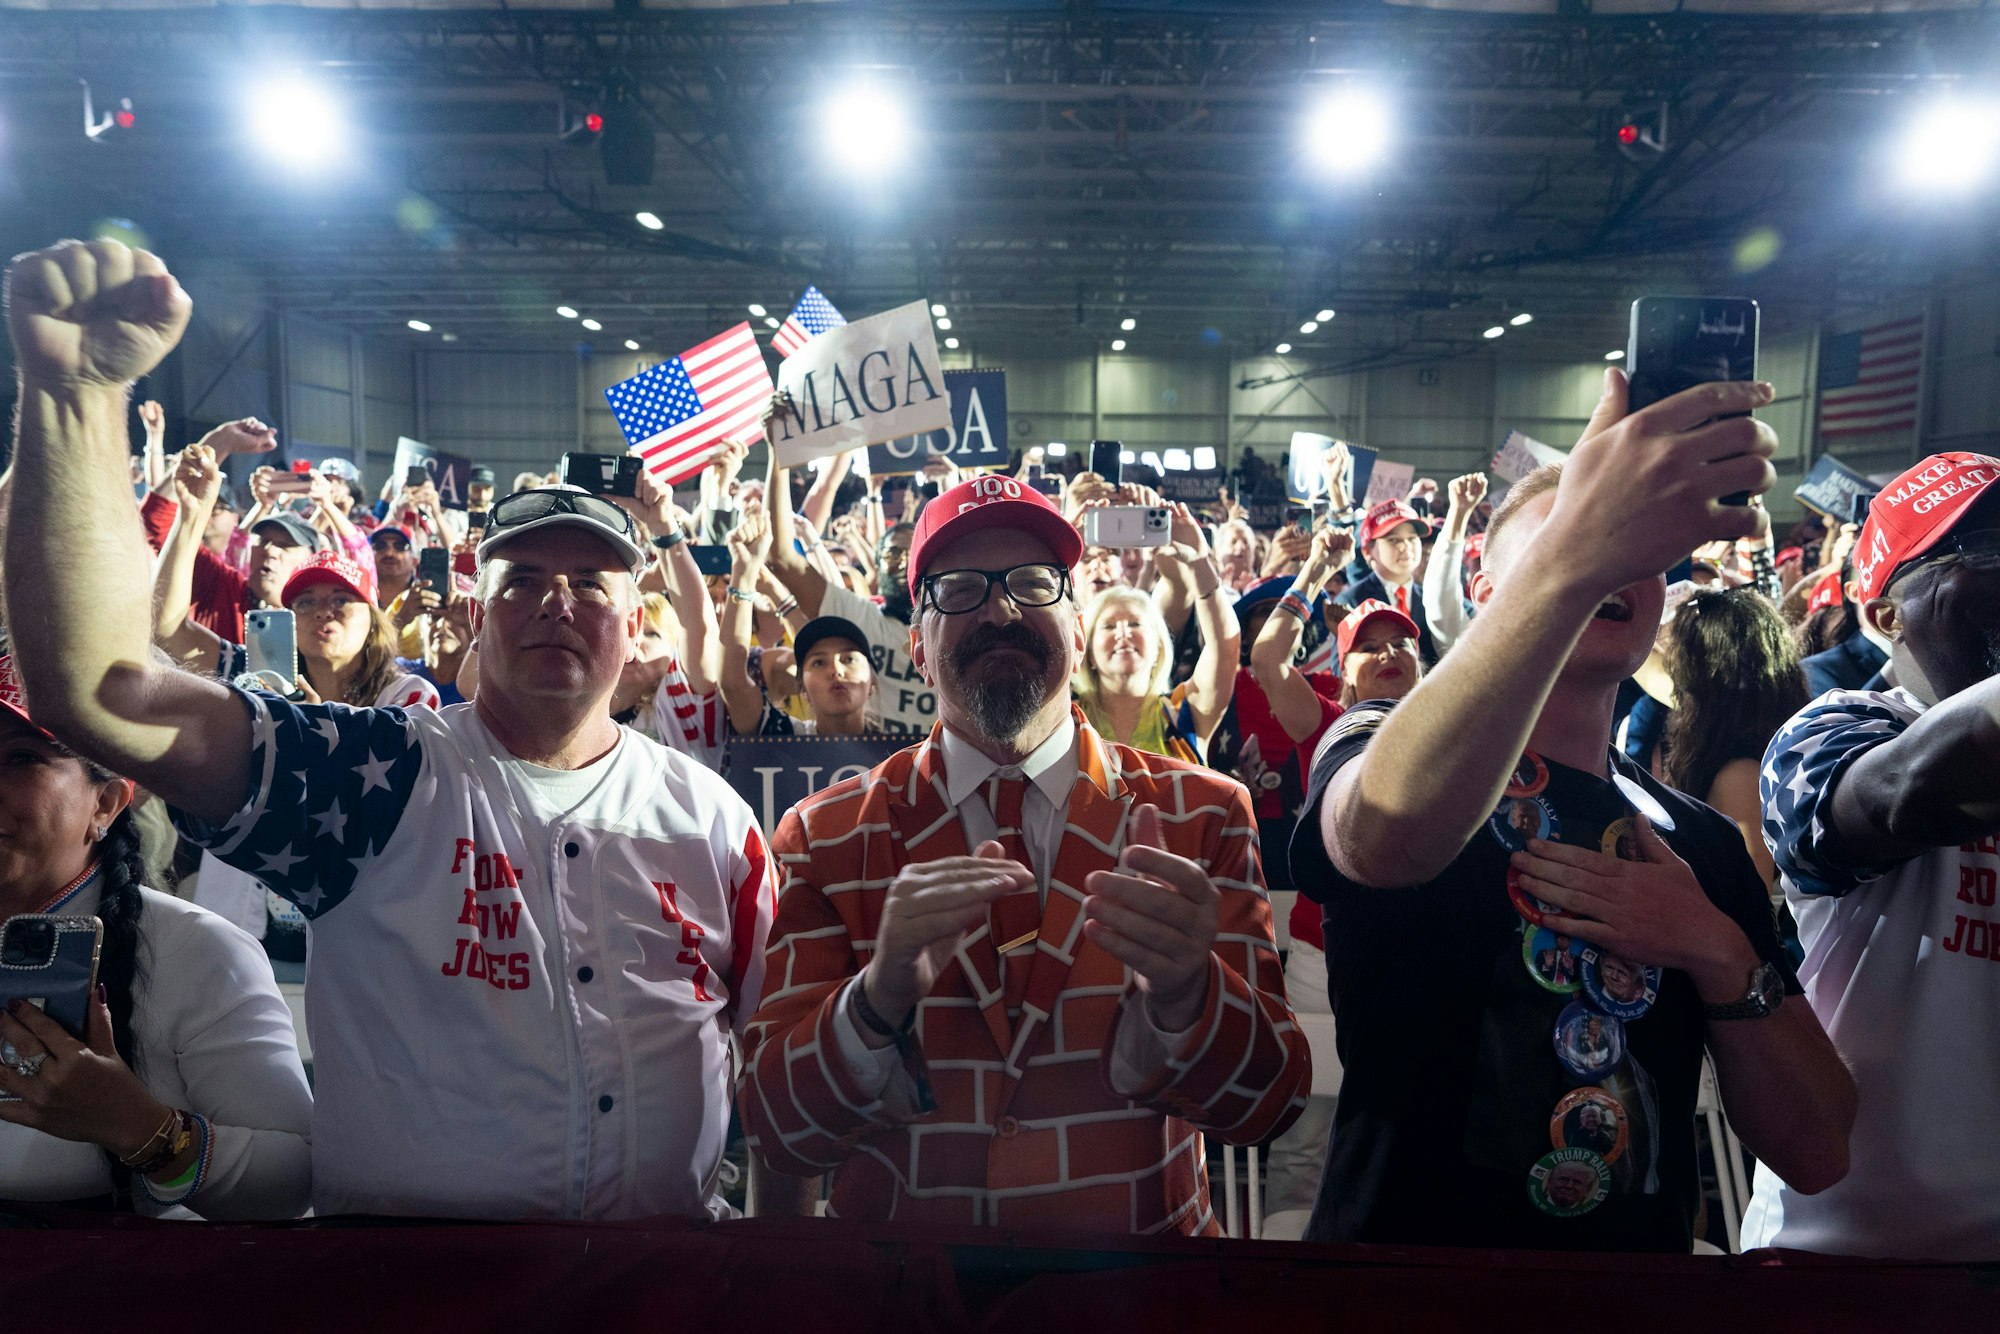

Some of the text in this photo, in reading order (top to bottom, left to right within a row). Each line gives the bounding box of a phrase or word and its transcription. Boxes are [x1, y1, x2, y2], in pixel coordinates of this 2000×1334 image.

[780, 341, 942, 441] MAGA
[971, 478, 1022, 498] 100
[1885, 461, 1953, 507] MAKE
[1912, 469, 1990, 514] GREAT
[898, 688, 937, 715] FO
[441, 938, 530, 991] JOES
[1550, 1150, 1612, 1181] TRUMP RALLY
